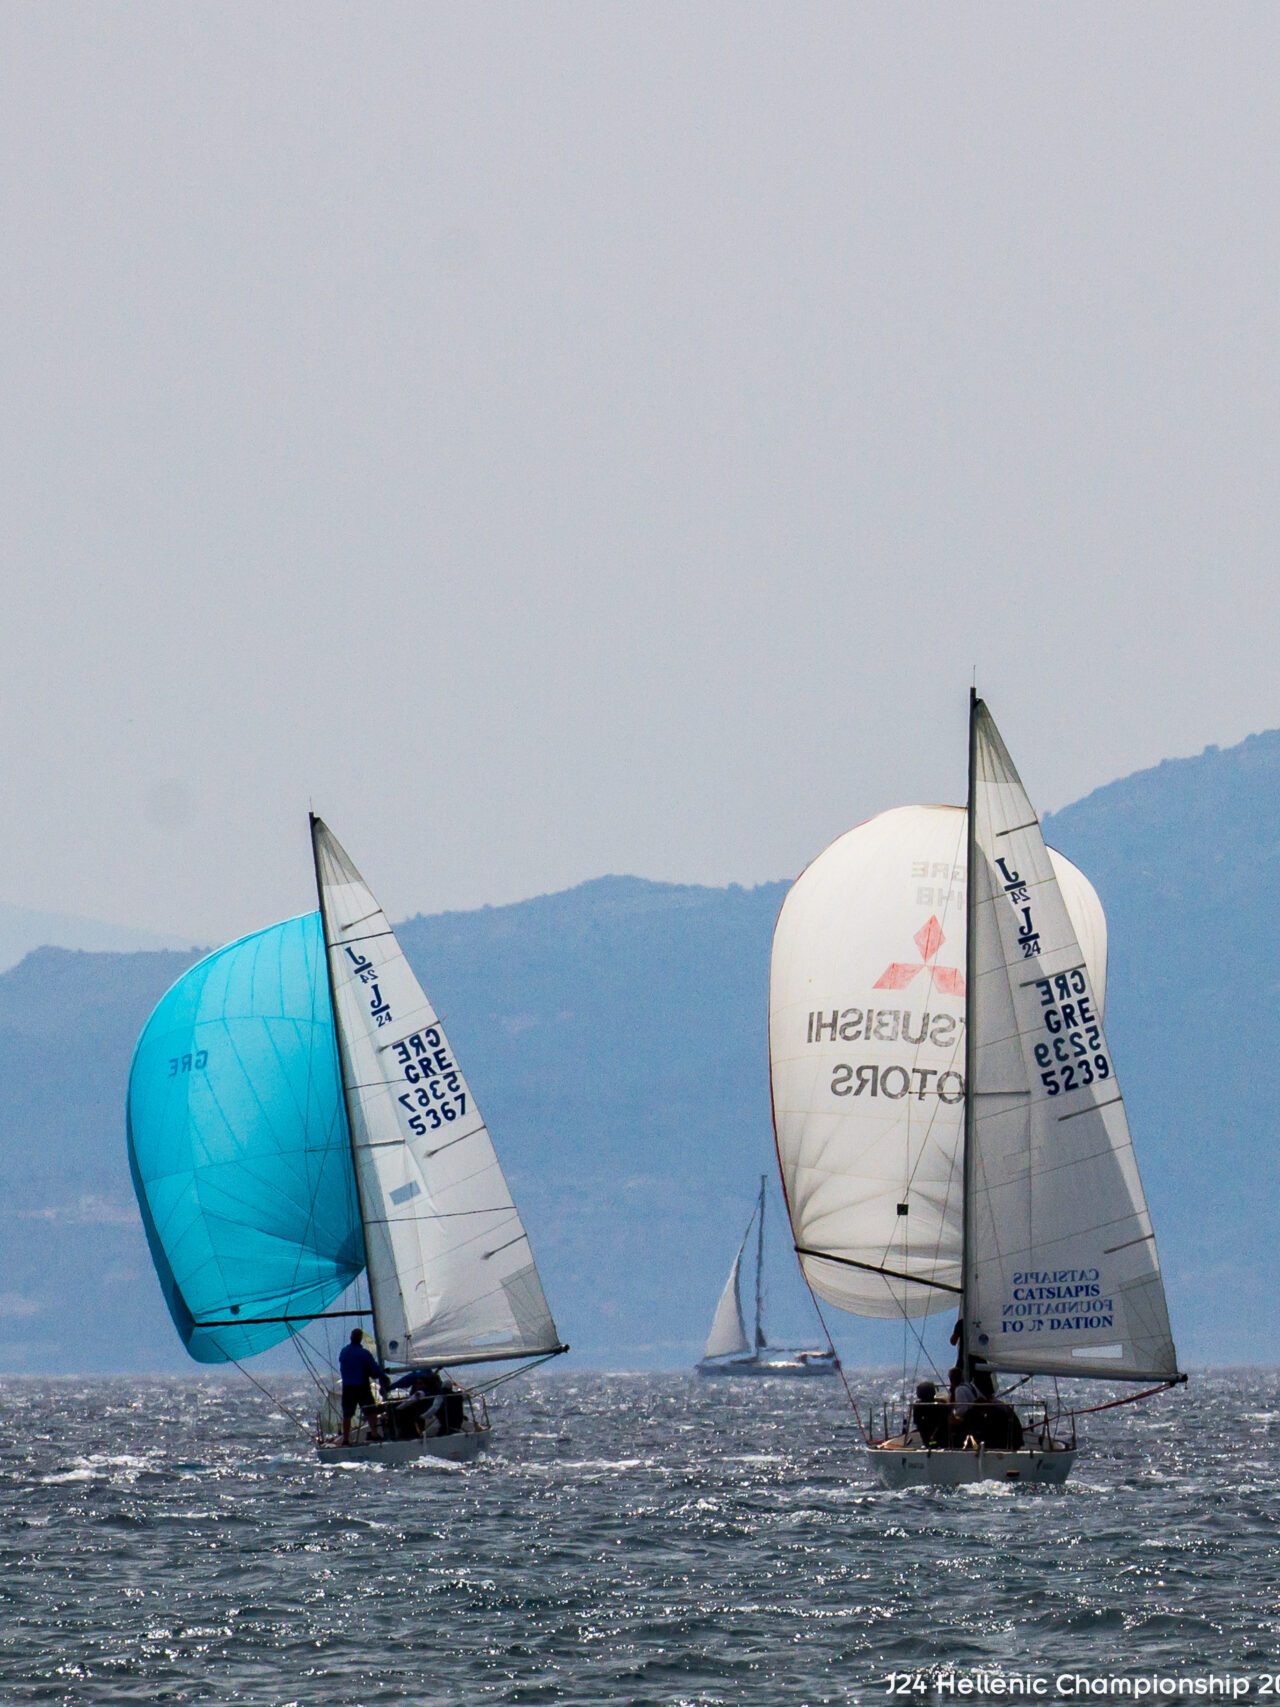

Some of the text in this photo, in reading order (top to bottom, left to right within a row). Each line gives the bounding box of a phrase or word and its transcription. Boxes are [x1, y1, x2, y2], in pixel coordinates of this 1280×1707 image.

[1019, 906, 1034, 936] J
[1022, 940, 1041, 958] 24
[370, 984, 382, 1008] J
[376, 1011, 392, 1028] 24
[1044, 997, 1096, 1034] GRE
[404, 1048, 453, 1084] GRE
[1041, 1054, 1110, 1096] 5239
[408, 1093, 466, 1136] 5367
